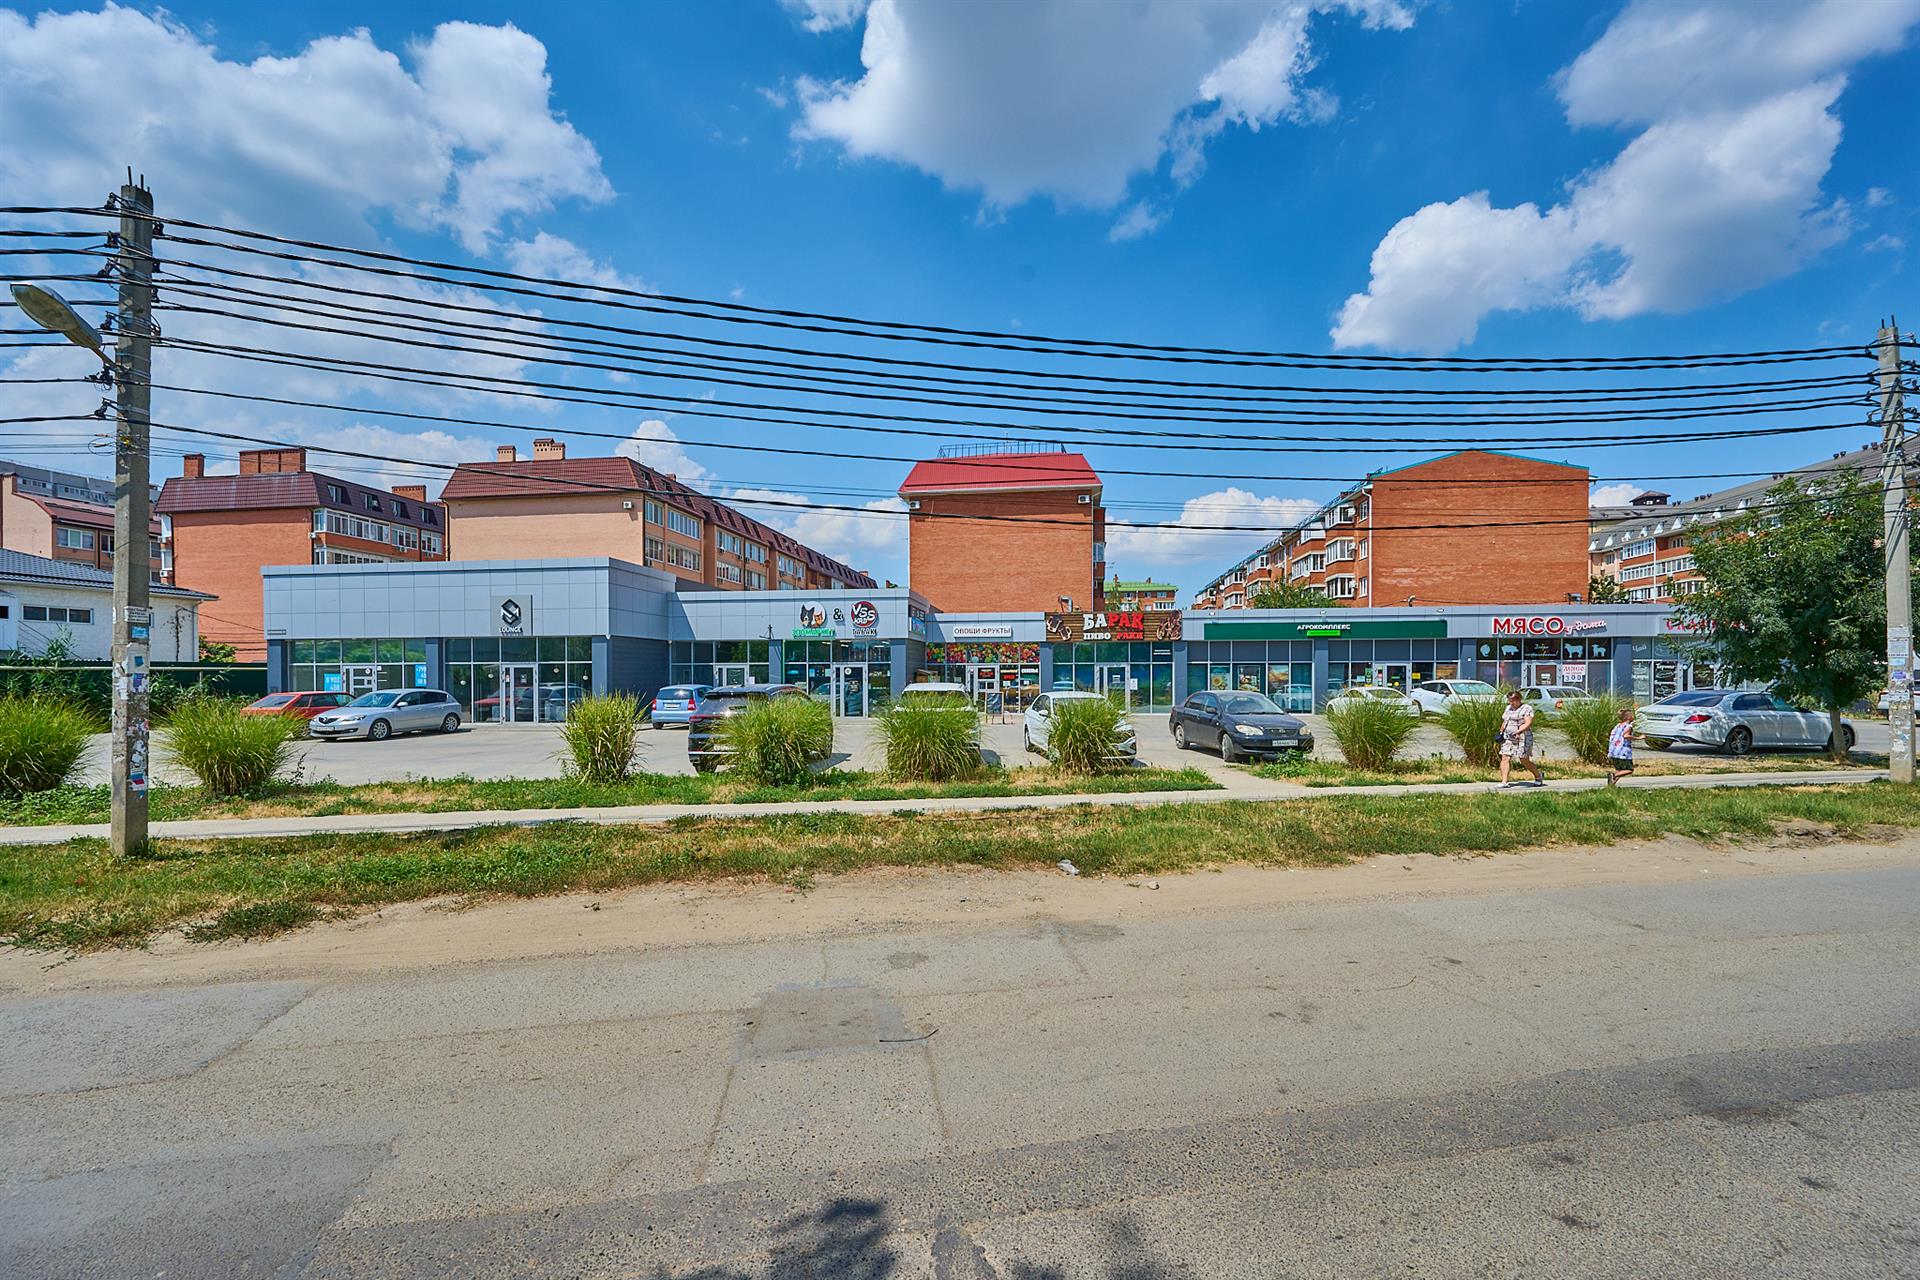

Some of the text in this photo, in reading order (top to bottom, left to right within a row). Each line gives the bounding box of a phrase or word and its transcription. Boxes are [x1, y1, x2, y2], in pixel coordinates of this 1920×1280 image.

[1083, 612, 1144, 631] БАРАК
[1492, 616, 1564, 634] МЯСО
[1083, 631, 1143, 640] ПИВО РАКИ
